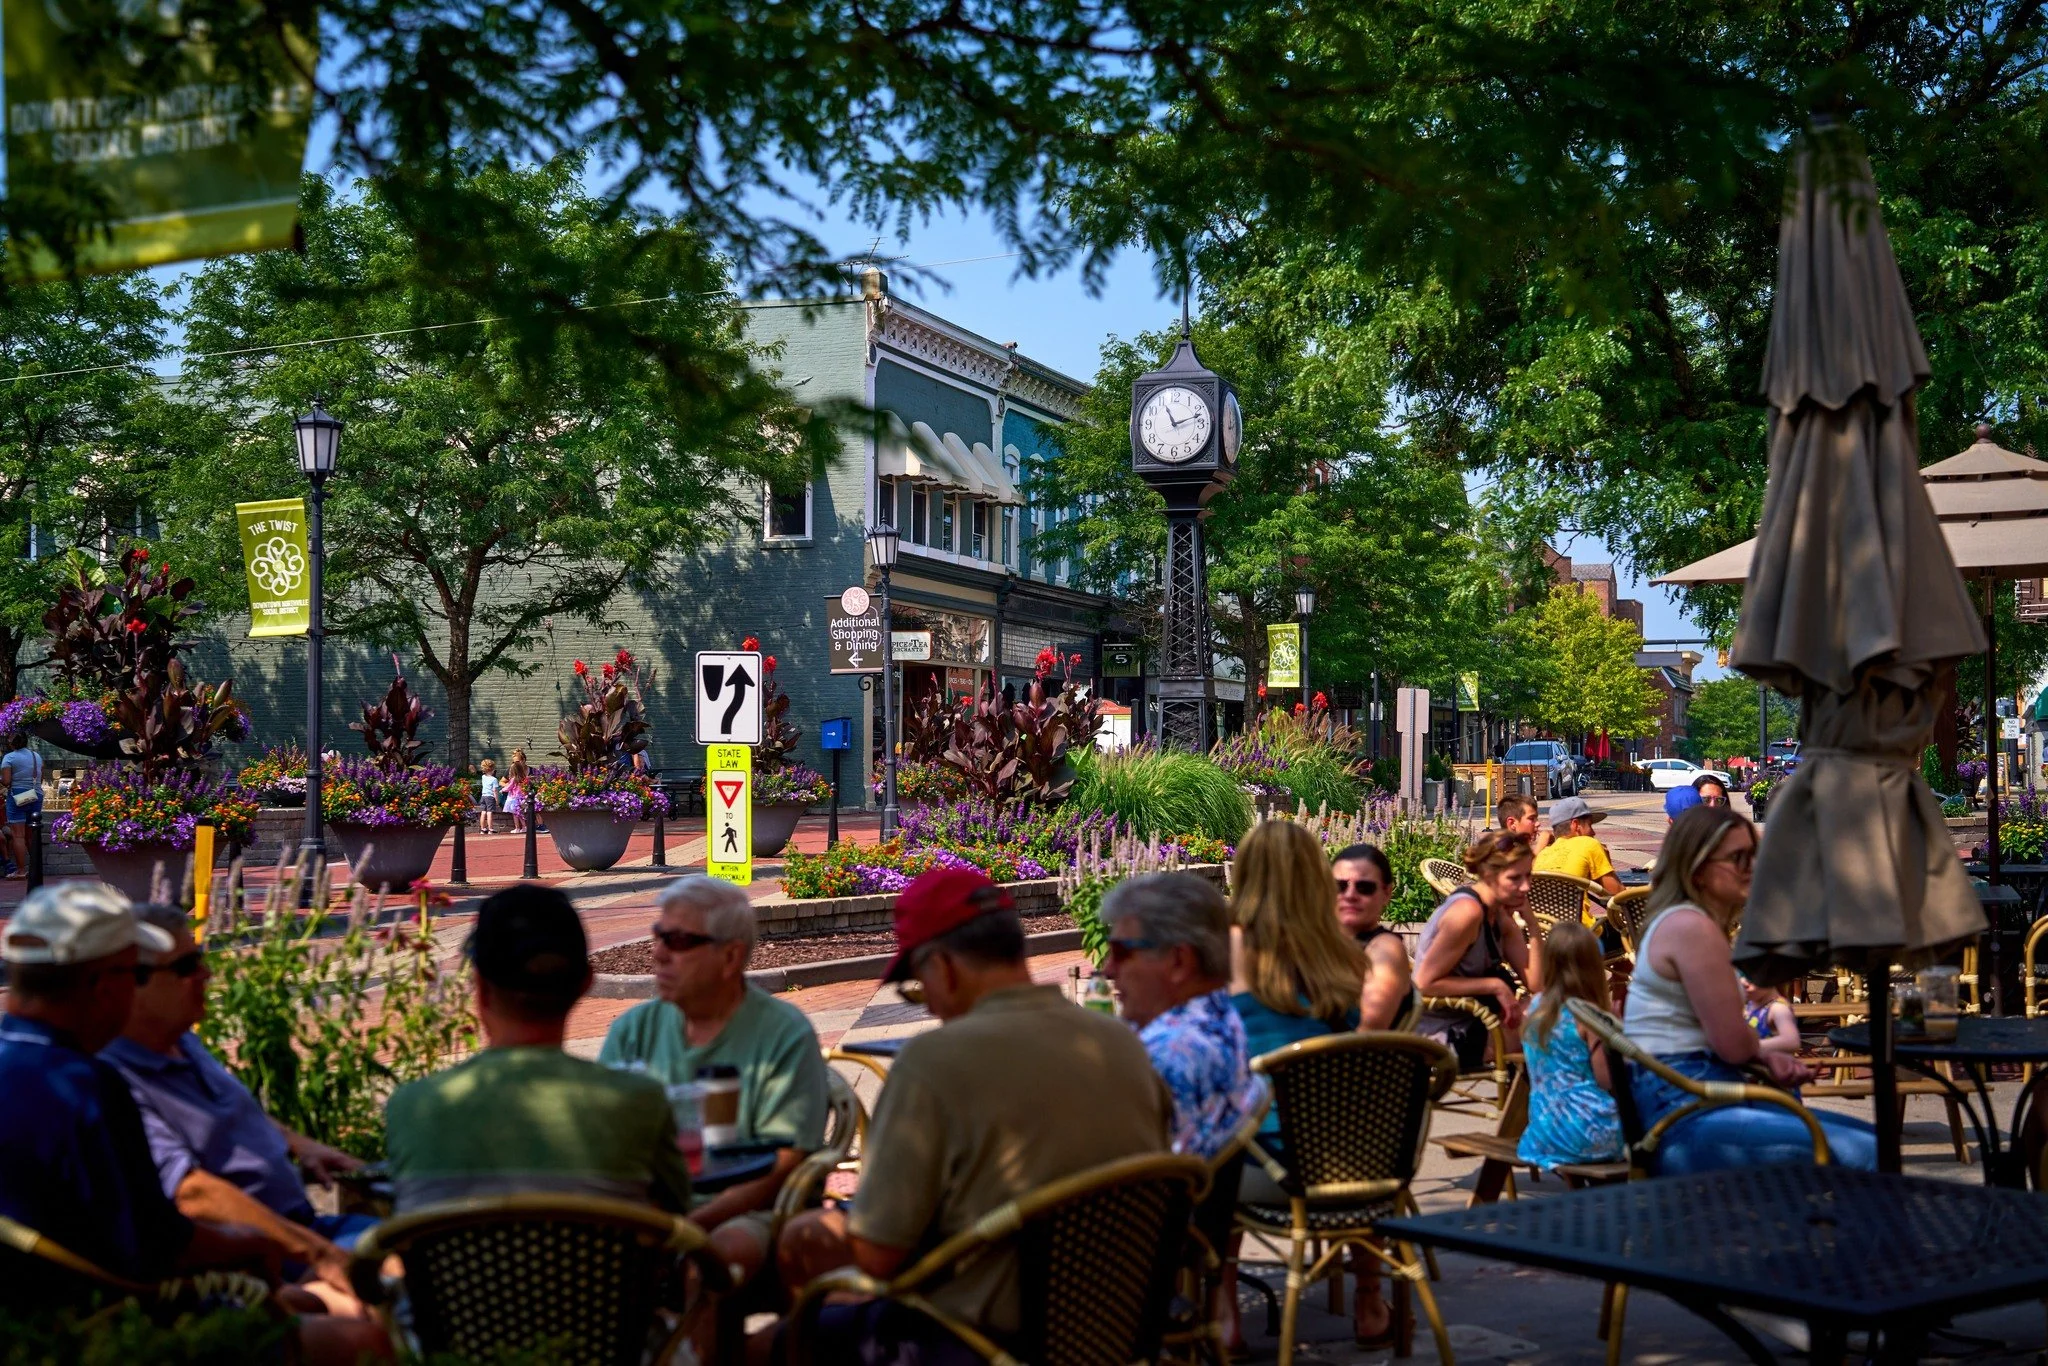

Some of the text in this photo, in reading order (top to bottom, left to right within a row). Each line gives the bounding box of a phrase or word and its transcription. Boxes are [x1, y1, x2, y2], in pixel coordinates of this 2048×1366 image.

[1158, 395, 1165, 407] 11
[1171, 391, 1180, 403] 12
[1187, 396, 1191, 407] 1
[1148, 405, 1158, 416] 10
[1194, 404, 1202, 416] 2
[1145, 419, 1153, 430] 9
[1197, 418, 1205, 430] 3
[1148, 433, 1156, 444] 8
[1192, 433, 1200, 444] 4
[1157, 443, 1164, 454] 7
[1170, 446, 1178, 458] 6
[1183, 442, 1191, 454] 5
[248, 519, 299, 536] THE TWIST
[831, 616, 880, 628] Additional
[832, 628, 878, 641] Shopping
[834, 640, 877, 652] & Dining
[1115, 654, 1128, 664] 5
[717, 748, 741, 758] STATE
[720, 759, 739, 769] LAW
[725, 812, 734, 820] TO
